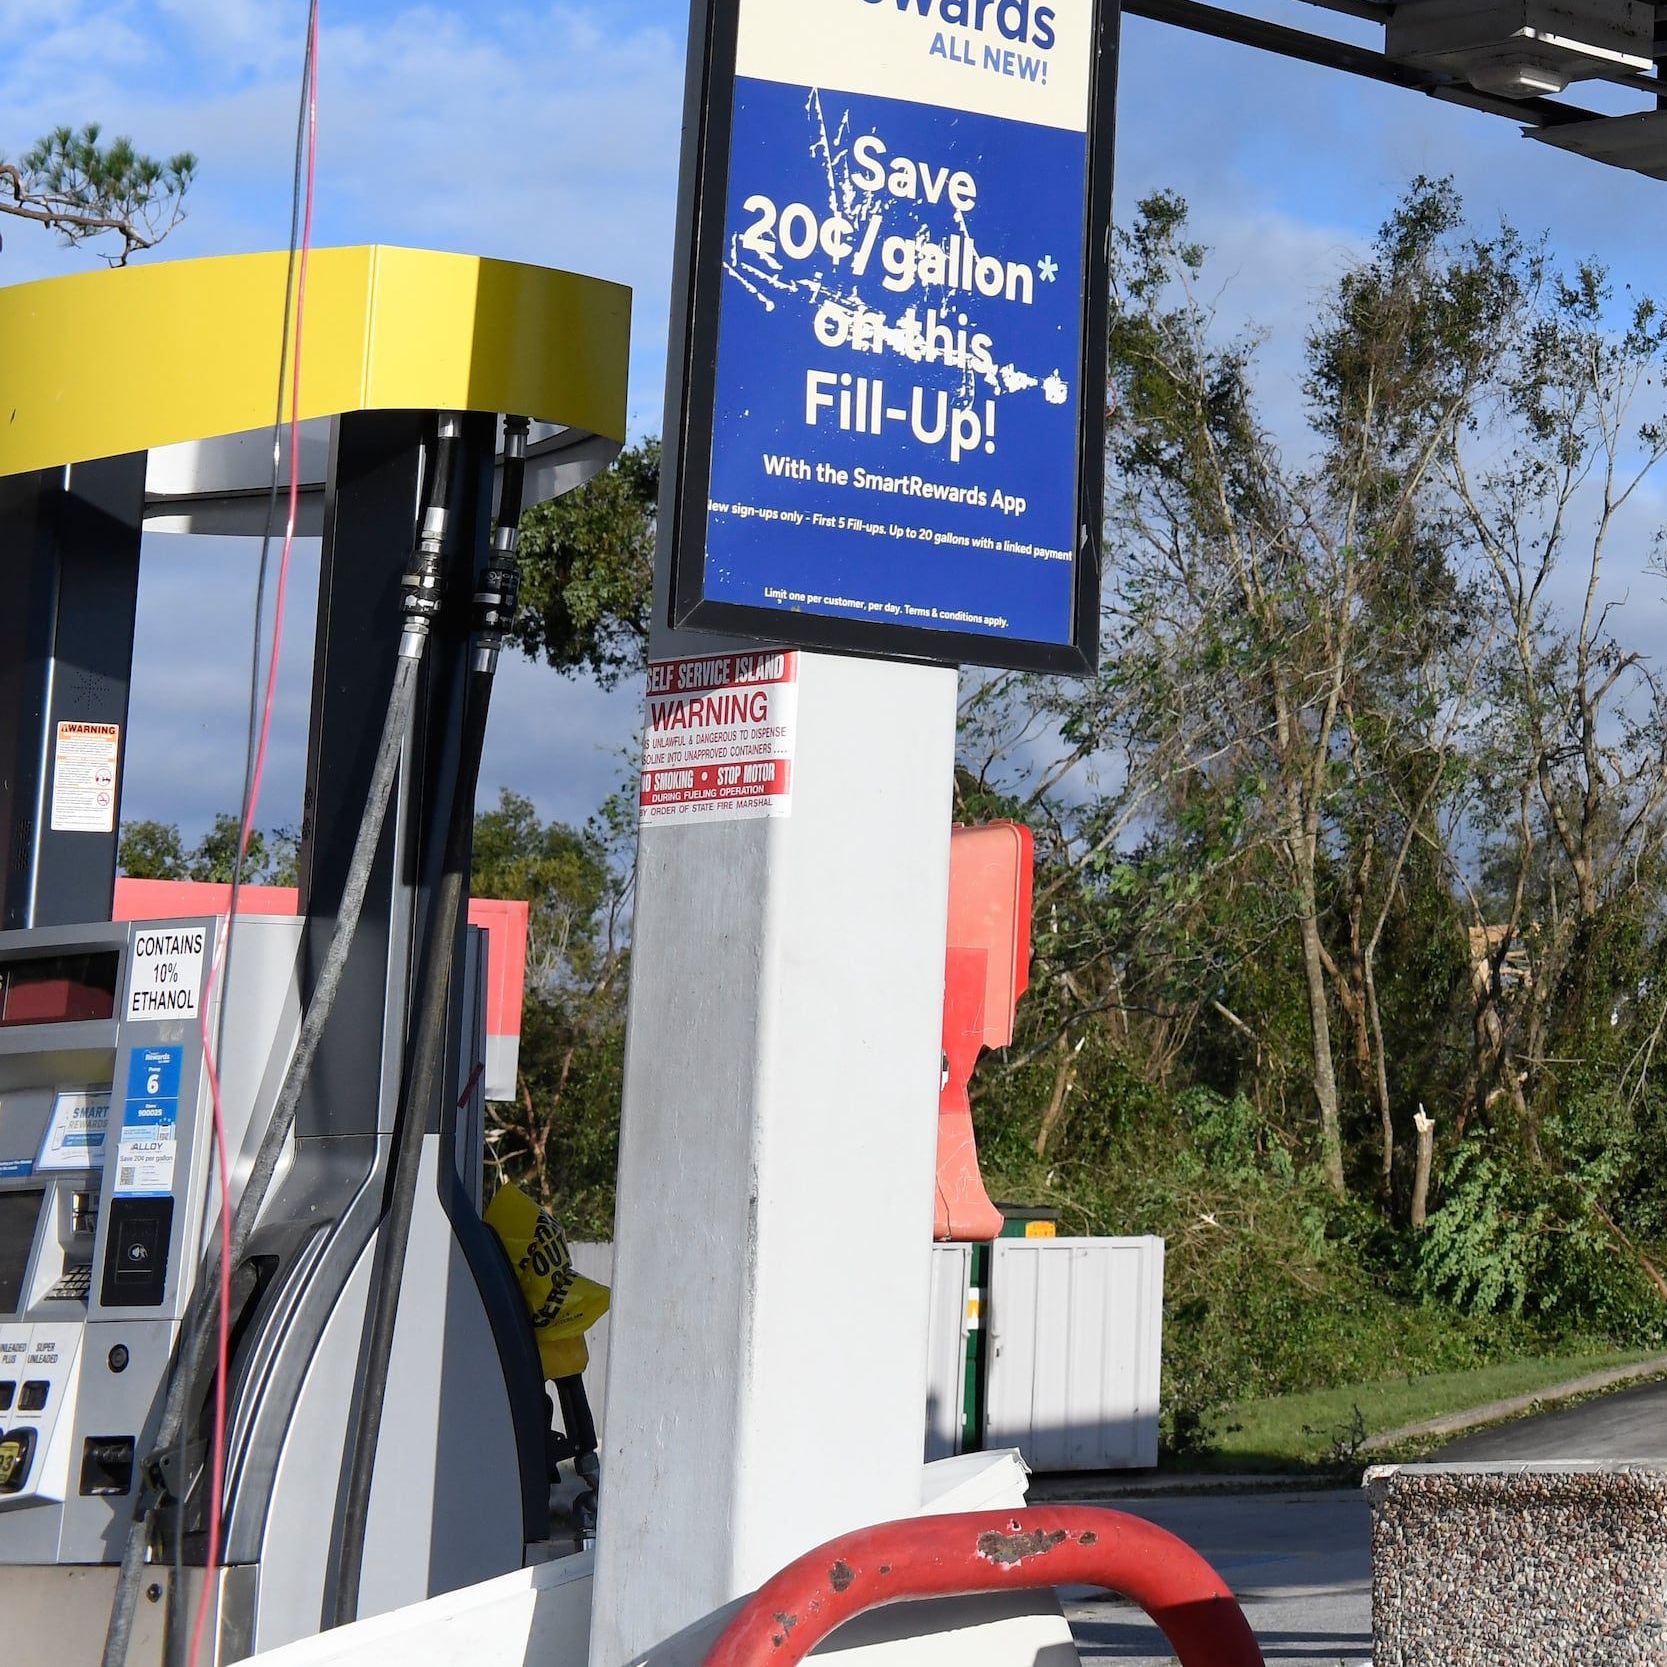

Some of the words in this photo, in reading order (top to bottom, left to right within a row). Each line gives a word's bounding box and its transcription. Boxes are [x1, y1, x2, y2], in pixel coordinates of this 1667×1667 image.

[929, 32, 976, 66] ALL
[983, 45, 1048, 86] NEW!
[850, 135, 978, 211] Save
[814, 299, 886, 354] on
[897, 308, 995, 375] this
[805, 370, 996, 463] Fill-Up!
[763, 454, 812, 481] With
[816, 462, 849, 486] the
[853, 467, 988, 507] SmartRewards
[991, 489, 1027, 517] App
[731, 502, 778, 521] sign-ups
[780, 510, 804, 525] only
[812, 513, 836, 528] First
[838, 518, 846, 529] 5
[847, 518, 887, 536] Fill-ups.
[889, 524, 904, 540] Up
[906, 527, 917, 539] to
[918, 528, 933, 541] 20
[934, 532, 970, 547] gallons
[972, 536, 994, 550] with
[995, 542, 1002, 551] a
[1003, 540, 1033, 556] linked
[1033, 546, 1073, 561] payment
[764, 587, 788, 601] Limit
[788, 591, 806, 602] one
[806, 594, 823, 605] per
[823, 595, 867, 611] customer,
[868, 601, 884, 613] per
[884, 602, 903, 615] day.
[904, 604, 931, 618] Terms
[931, 608, 939, 618] &
[939, 610, 983, 624] conditions
[983, 616, 1009, 629] apply.
[647, 665, 675, 692] SELF
[677, 658, 732, 689] SERVICE
[734, 654, 785, 683] ISLAND
[651, 691, 768, 732] WARNING
[67, 724, 116, 734] WARNING
[652, 735, 686, 749] UNLAWFUL
[689, 735, 693, 745] &
[696, 730, 737, 744] DANGEROUS
[740, 730, 749, 740] TO
[751, 726, 787, 739] DISPENSE
[667, 752, 682, 763] INTO
[684, 747, 728, 762] UNAPPROVED
[730, 743, 772, 758] CONTAINERS
[641, 773, 652, 793] NO
[653, 769, 694, 791] SMOKING
[717, 766, 741, 786] STOP
[743, 762, 776, 784] MOTOR
[652, 792, 682, 803] DURING
[683, 788, 717, 800] FUELING
[719, 784, 765, 797] OPERATION
[650, 805, 676, 816] ORDER
[679, 804, 690, 814] OF
[692, 802, 714, 813] STATE
[716, 800, 734, 811] FIRE
[735, 797, 774, 809] MARSHAL
[136, 934, 202, 957] CONTAINS
[153, 961, 178, 984] 10%
[132, 989, 195, 1012] ETHANOL
[147, 1074, 159, 1094] 6
[69, 1119, 109, 1129] REWARDS
[73, 1106, 110, 1119] SMART
[130, 1142, 163, 1151] ALLOY
[156, 1154, 173, 1163] gallon
[2, 1354, 16, 1364] PLUS
[27, 1354, 58, 1364] UNLEADED
[36, 1343, 55, 1352] SUPER
